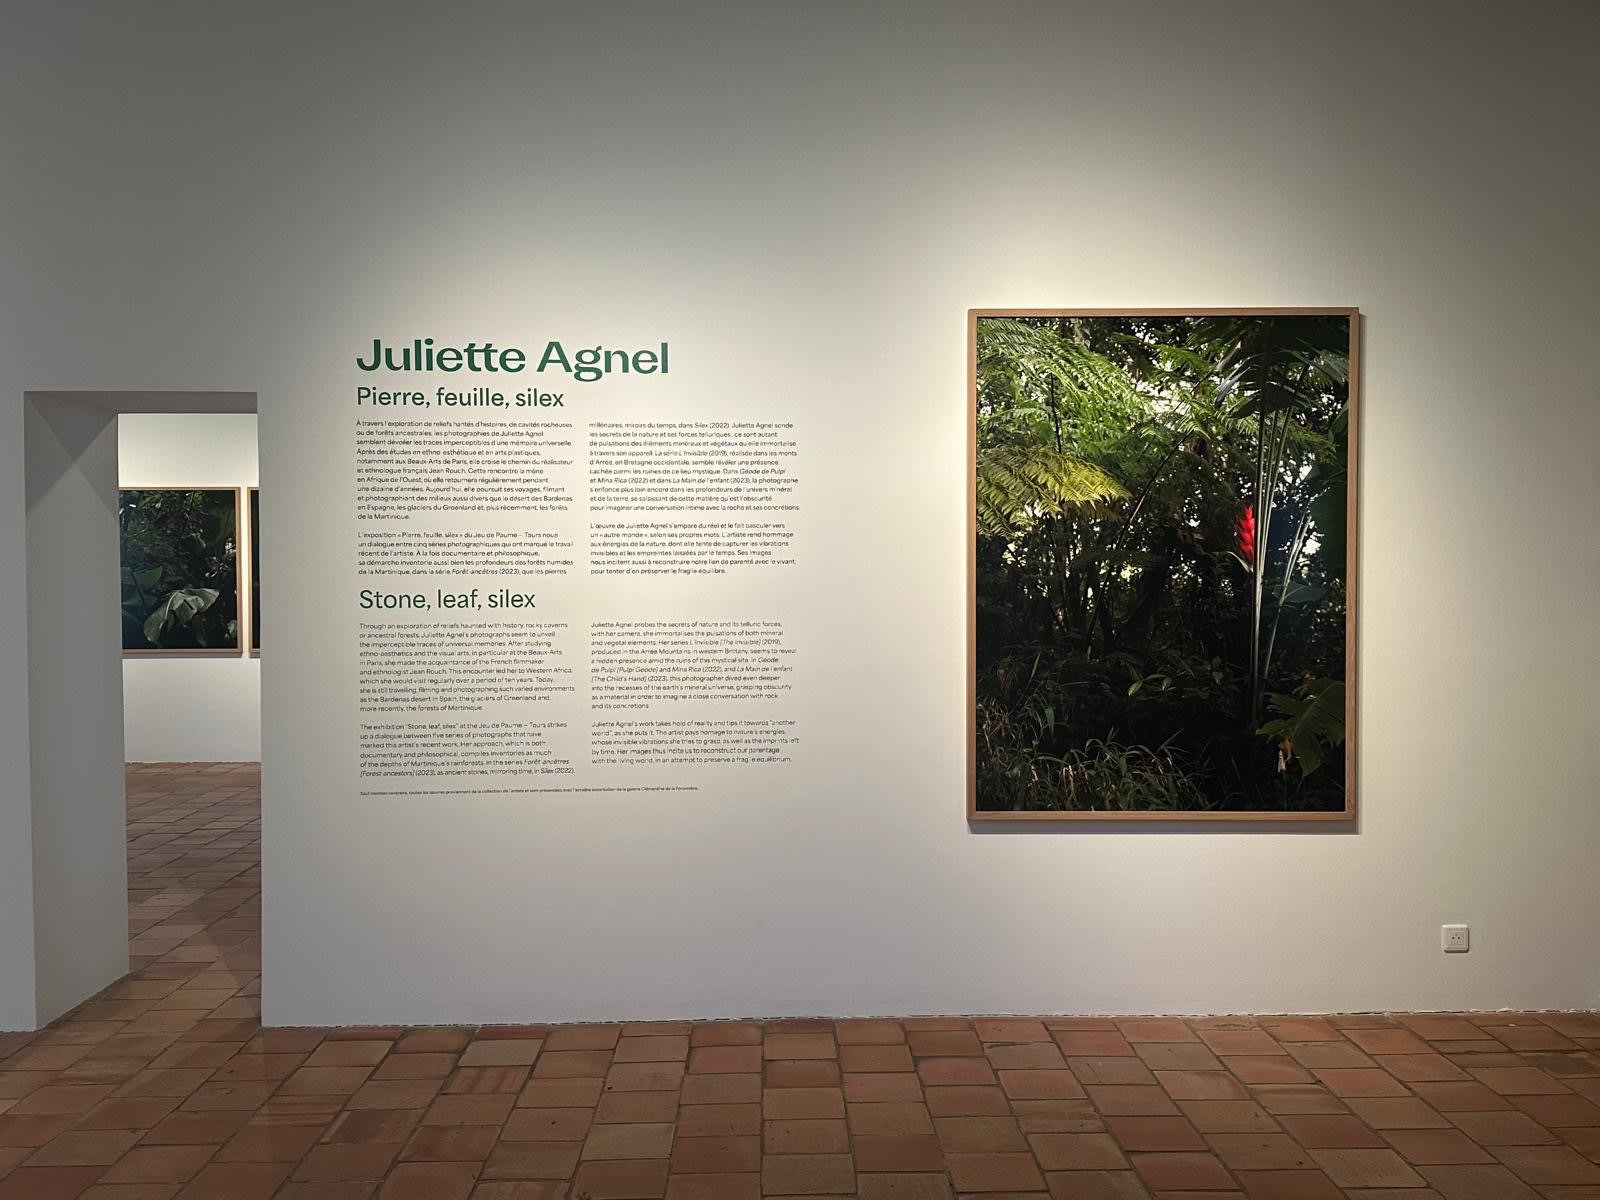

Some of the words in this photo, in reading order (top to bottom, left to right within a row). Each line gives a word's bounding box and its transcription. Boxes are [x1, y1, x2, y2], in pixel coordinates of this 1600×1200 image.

[356, 338, 527, 373] Juliette
[536, 341, 669, 382] Agnel
[357, 387, 430, 408] Pierre,
[436, 386, 511, 409] feuille,
[515, 388, 564, 407] silex
[755, 422, 773, 430] Agnel
[443, 430, 489, 438] photographies
[442, 439, 490, 447] imperceptibles
[598, 440, 630, 448] pulsations
[623, 459, 652, 467] Bretagne
[364, 467, 401, 475] ethnologue
[366, 476, 389, 484] Afrique
[522, 476, 548, 484] pendant
[758, 476, 798, 485] photographe
[620, 486, 633, 494] plus
[695, 486, 733, 494] profondeurs
[364, 494, 415, 503] photographiant
[761, 531, 793, 539] hommage
[367, 540, 394, 549] dialogue
[412, 540, 427, 549] cinq
[446, 540, 500, 549] photographiques
[721, 540, 748, 548] capturer
[636, 549, 671, 558] empreintes
[474, 559, 513, 567] profondeurs
[544, 568, 566, 576] pierres
[360, 590, 431, 610] Stone,
[438, 589, 482, 611] leaf,
[487, 589, 536, 609] silex
[359, 622, 386, 631] Through
[396, 622, 432, 631] exploration
[633, 621, 655, 629] probes
[469, 631, 510, 639] photographs
[524, 640, 551, 648] studying
[603, 639, 626, 647] vegetal
[478, 649, 508, 658] particular
[591, 648, 621, 656] produced
[711, 656, 737, 665] mystical
[426, 677, 455, 685] regularly
[681, 675, 724, 683] photographer
[758, 674, 781, 683] deeper
[452, 686, 498, 694] photographing
[374, 732, 402, 741] dialogue
[471, 731, 512, 740] photographs
[360, 751, 403, 759] documentary
[379, 760, 402, 768] depths
[489, 768, 518, 776] mirroring
